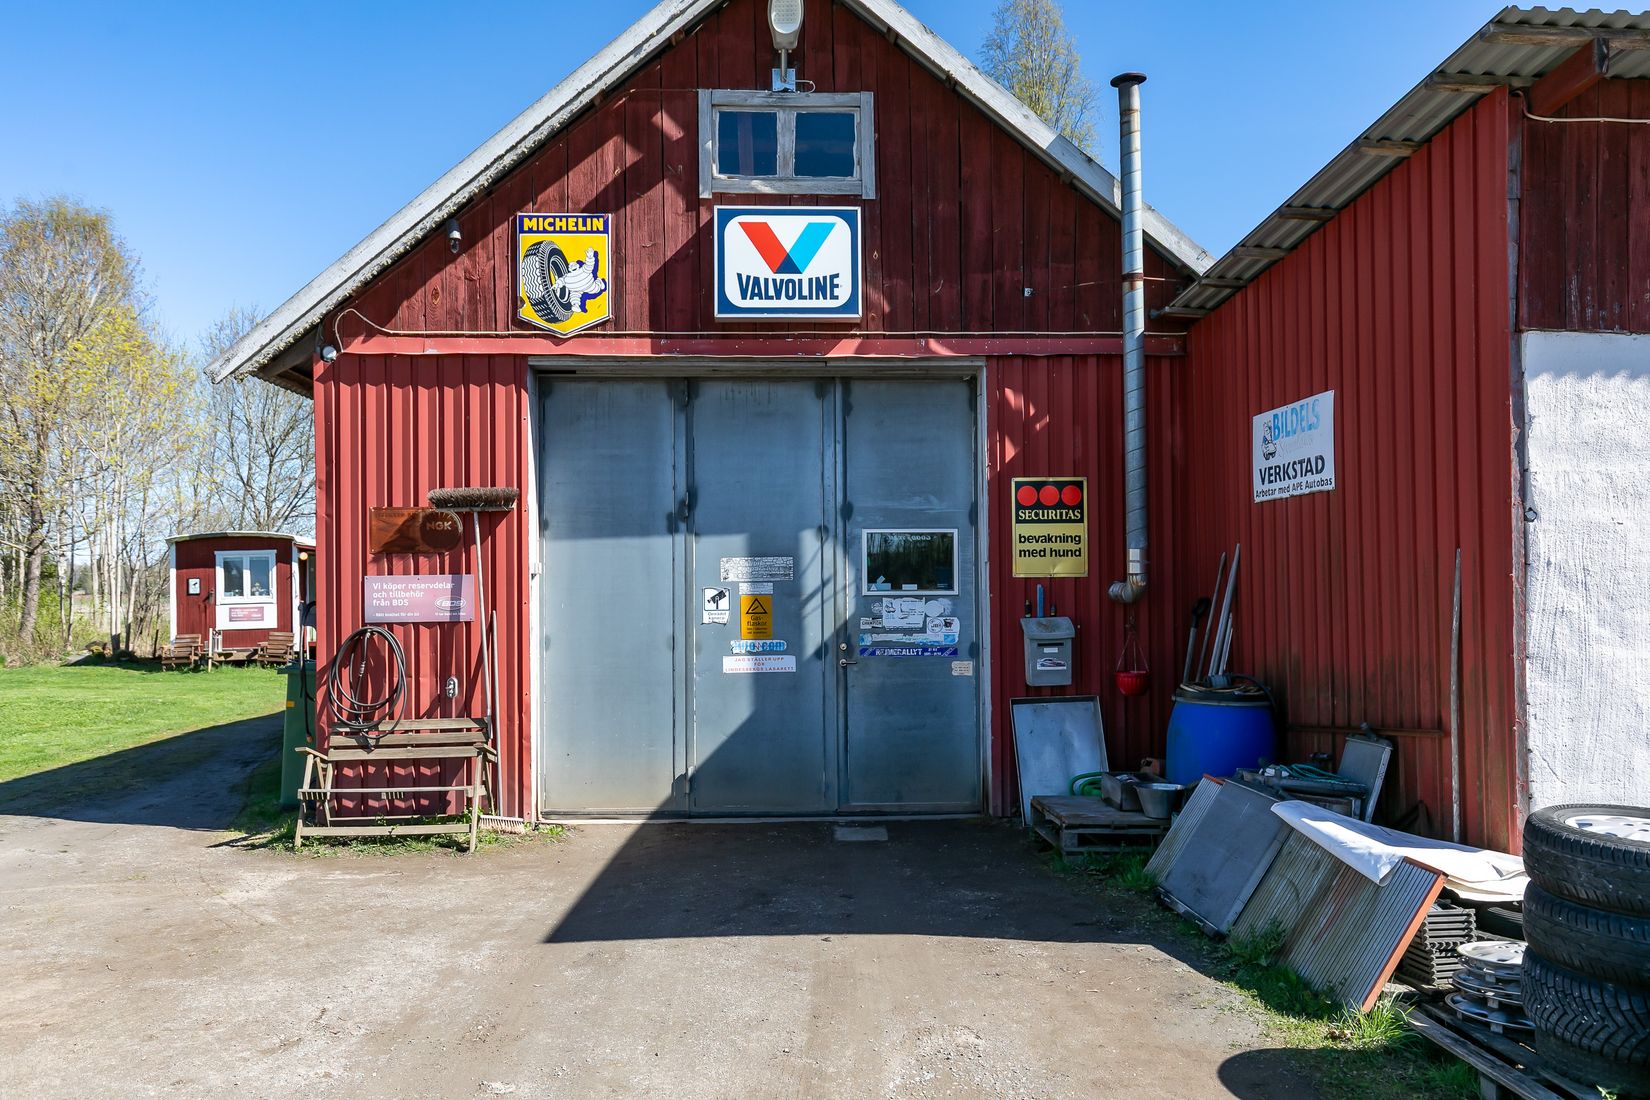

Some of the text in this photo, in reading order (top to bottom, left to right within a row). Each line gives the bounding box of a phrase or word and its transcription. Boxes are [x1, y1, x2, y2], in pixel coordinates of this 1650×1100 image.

[523, 217, 604, 232] MICHELIN
[736, 272, 840, 301] VALVOLINE
[1259, 454, 1326, 486] VERKSTAD
[1255, 487, 1277, 499] Arbetar
[1277, 484, 1290, 495] med
[1304, 477, 1333, 489] Autobas
[1018, 509, 1081, 520] SECURITAS
[426, 521, 452, 531] NGK
[1018, 533, 1082, 546] bevakning
[1018, 547, 1082, 558] med hund
[383, 582, 406, 591] köper
[372, 599, 390, 607] från
